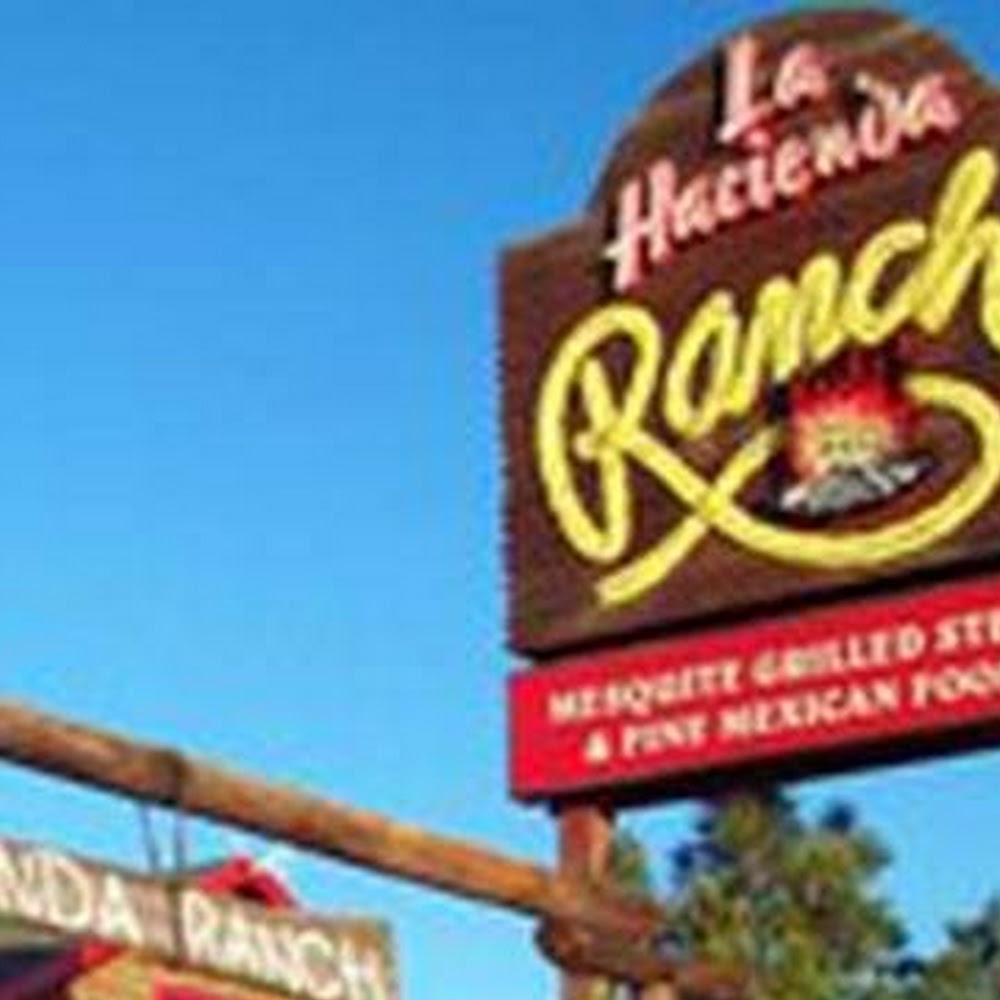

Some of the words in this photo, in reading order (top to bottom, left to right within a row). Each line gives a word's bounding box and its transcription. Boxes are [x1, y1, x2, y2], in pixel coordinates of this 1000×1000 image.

[717, 35, 829, 144] La
[605, 72, 962, 292] Hacienda
[535, 147, 1000, 606] Ranch
[548, 659, 741, 724] MESQUITE
[752, 623, 926, 687] GRILLED
[621, 713, 709, 760] FINE
[719, 677, 899, 740] MEXICAN
[910, 658, 1000, 711] FOO
